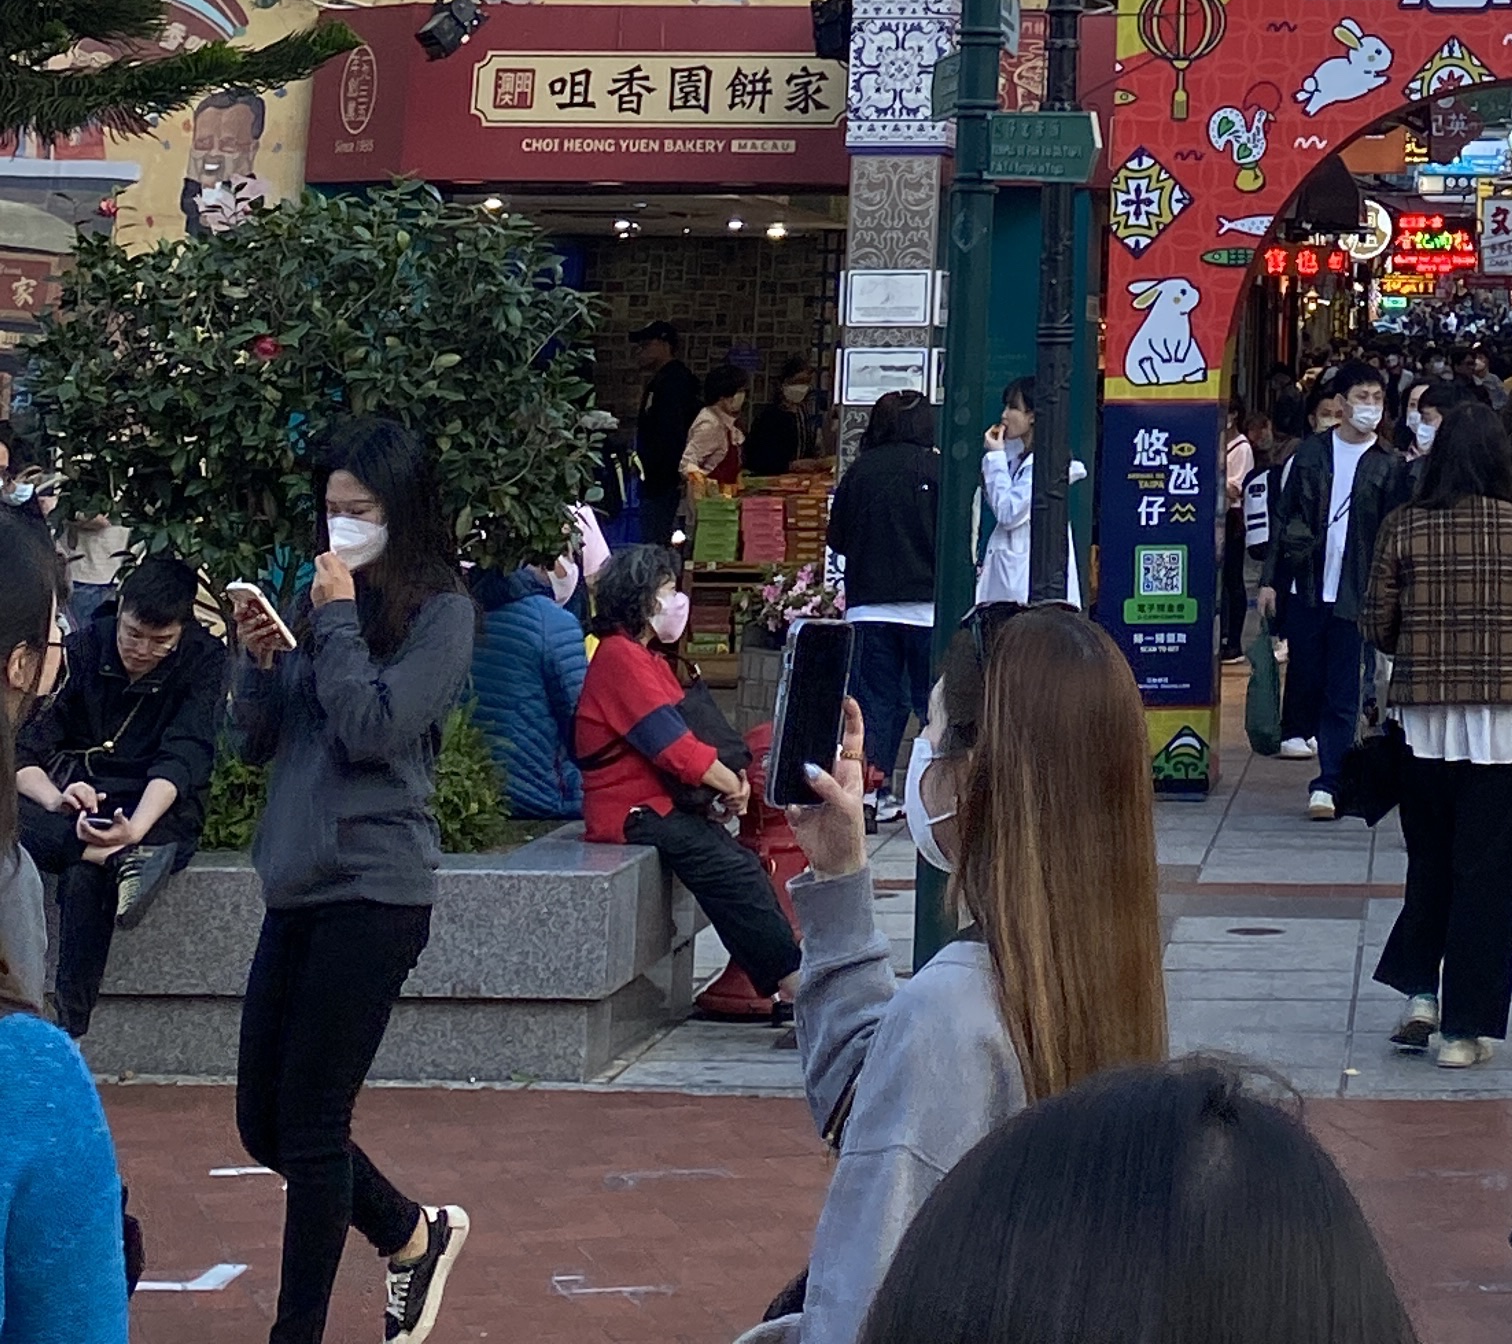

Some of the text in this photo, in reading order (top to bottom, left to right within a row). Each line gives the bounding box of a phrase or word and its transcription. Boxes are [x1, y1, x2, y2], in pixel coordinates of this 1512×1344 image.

[548, 64, 831, 116] 咀香園餅家
[522, 138, 791, 154] CHOI HEONG YUEN BAKERY MACAU
